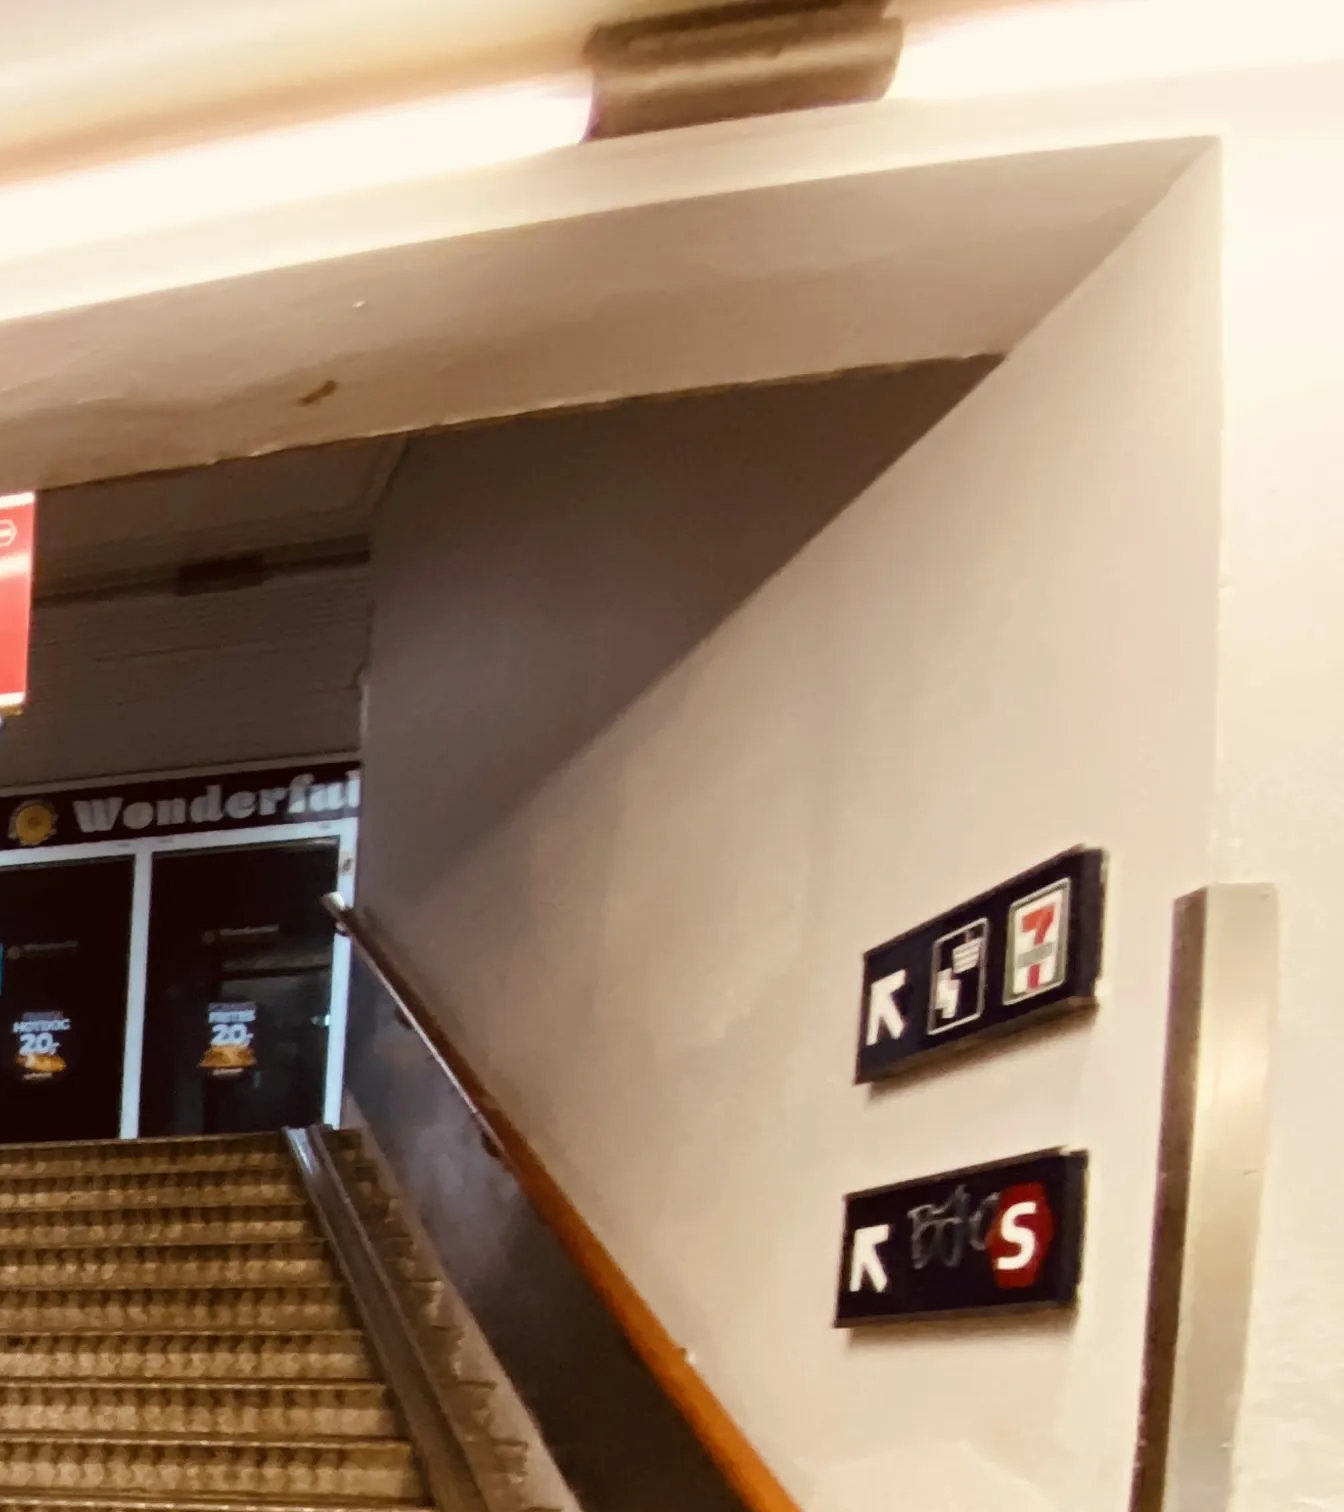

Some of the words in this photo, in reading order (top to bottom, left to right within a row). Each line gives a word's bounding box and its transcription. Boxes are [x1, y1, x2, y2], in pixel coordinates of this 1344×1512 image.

[72, 769, 361, 833] Wonderful
[1021, 902, 1056, 990] 7
[997, 1201, 1037, 1270] S
